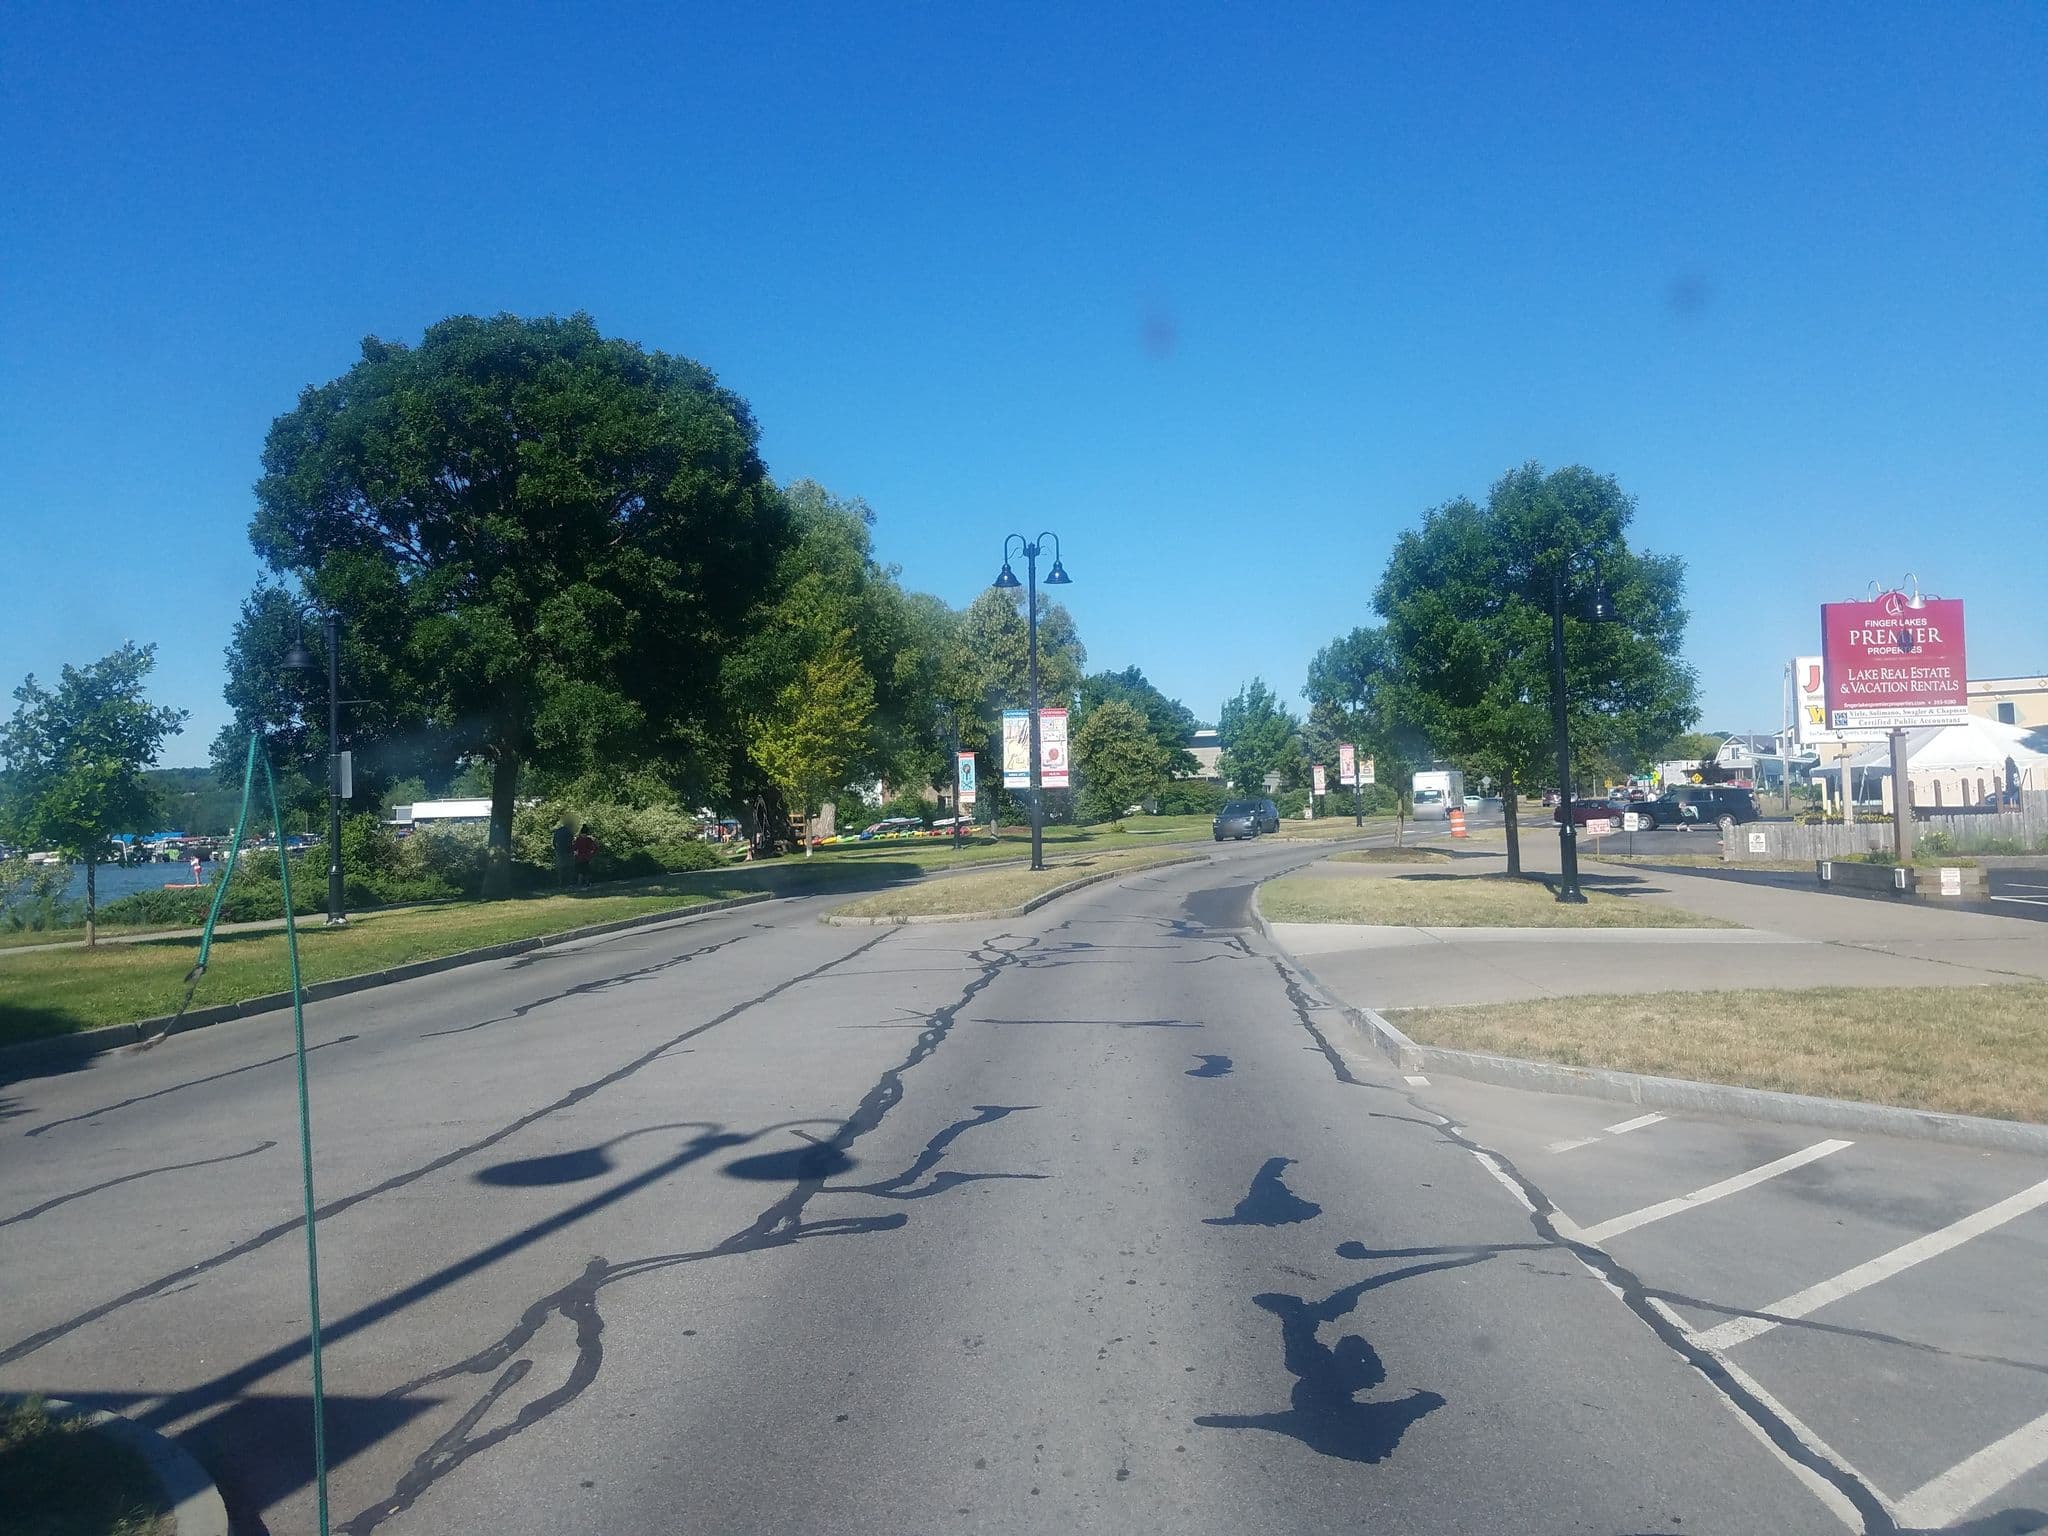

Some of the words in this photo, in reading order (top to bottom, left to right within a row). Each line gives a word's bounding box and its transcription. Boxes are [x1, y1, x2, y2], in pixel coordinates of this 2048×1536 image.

[1865, 619, 1897, 628] FINGER
[1899, 618, 1927, 627] LAKES
[1849, 627, 1943, 645] PREMIER
[1848, 668, 1879, 680] LAKE
[1881, 667, 1909, 679] REAL
[1911, 666, 1951, 679] ESTATE
[1840, 683, 1850, 694] &
[1851, 681, 1908, 693] VACATION
[1911, 680, 1959, 692] RENTALS
[1858, 718, 1891, 727] Certified
[1894, 717, 1917, 725] Public
